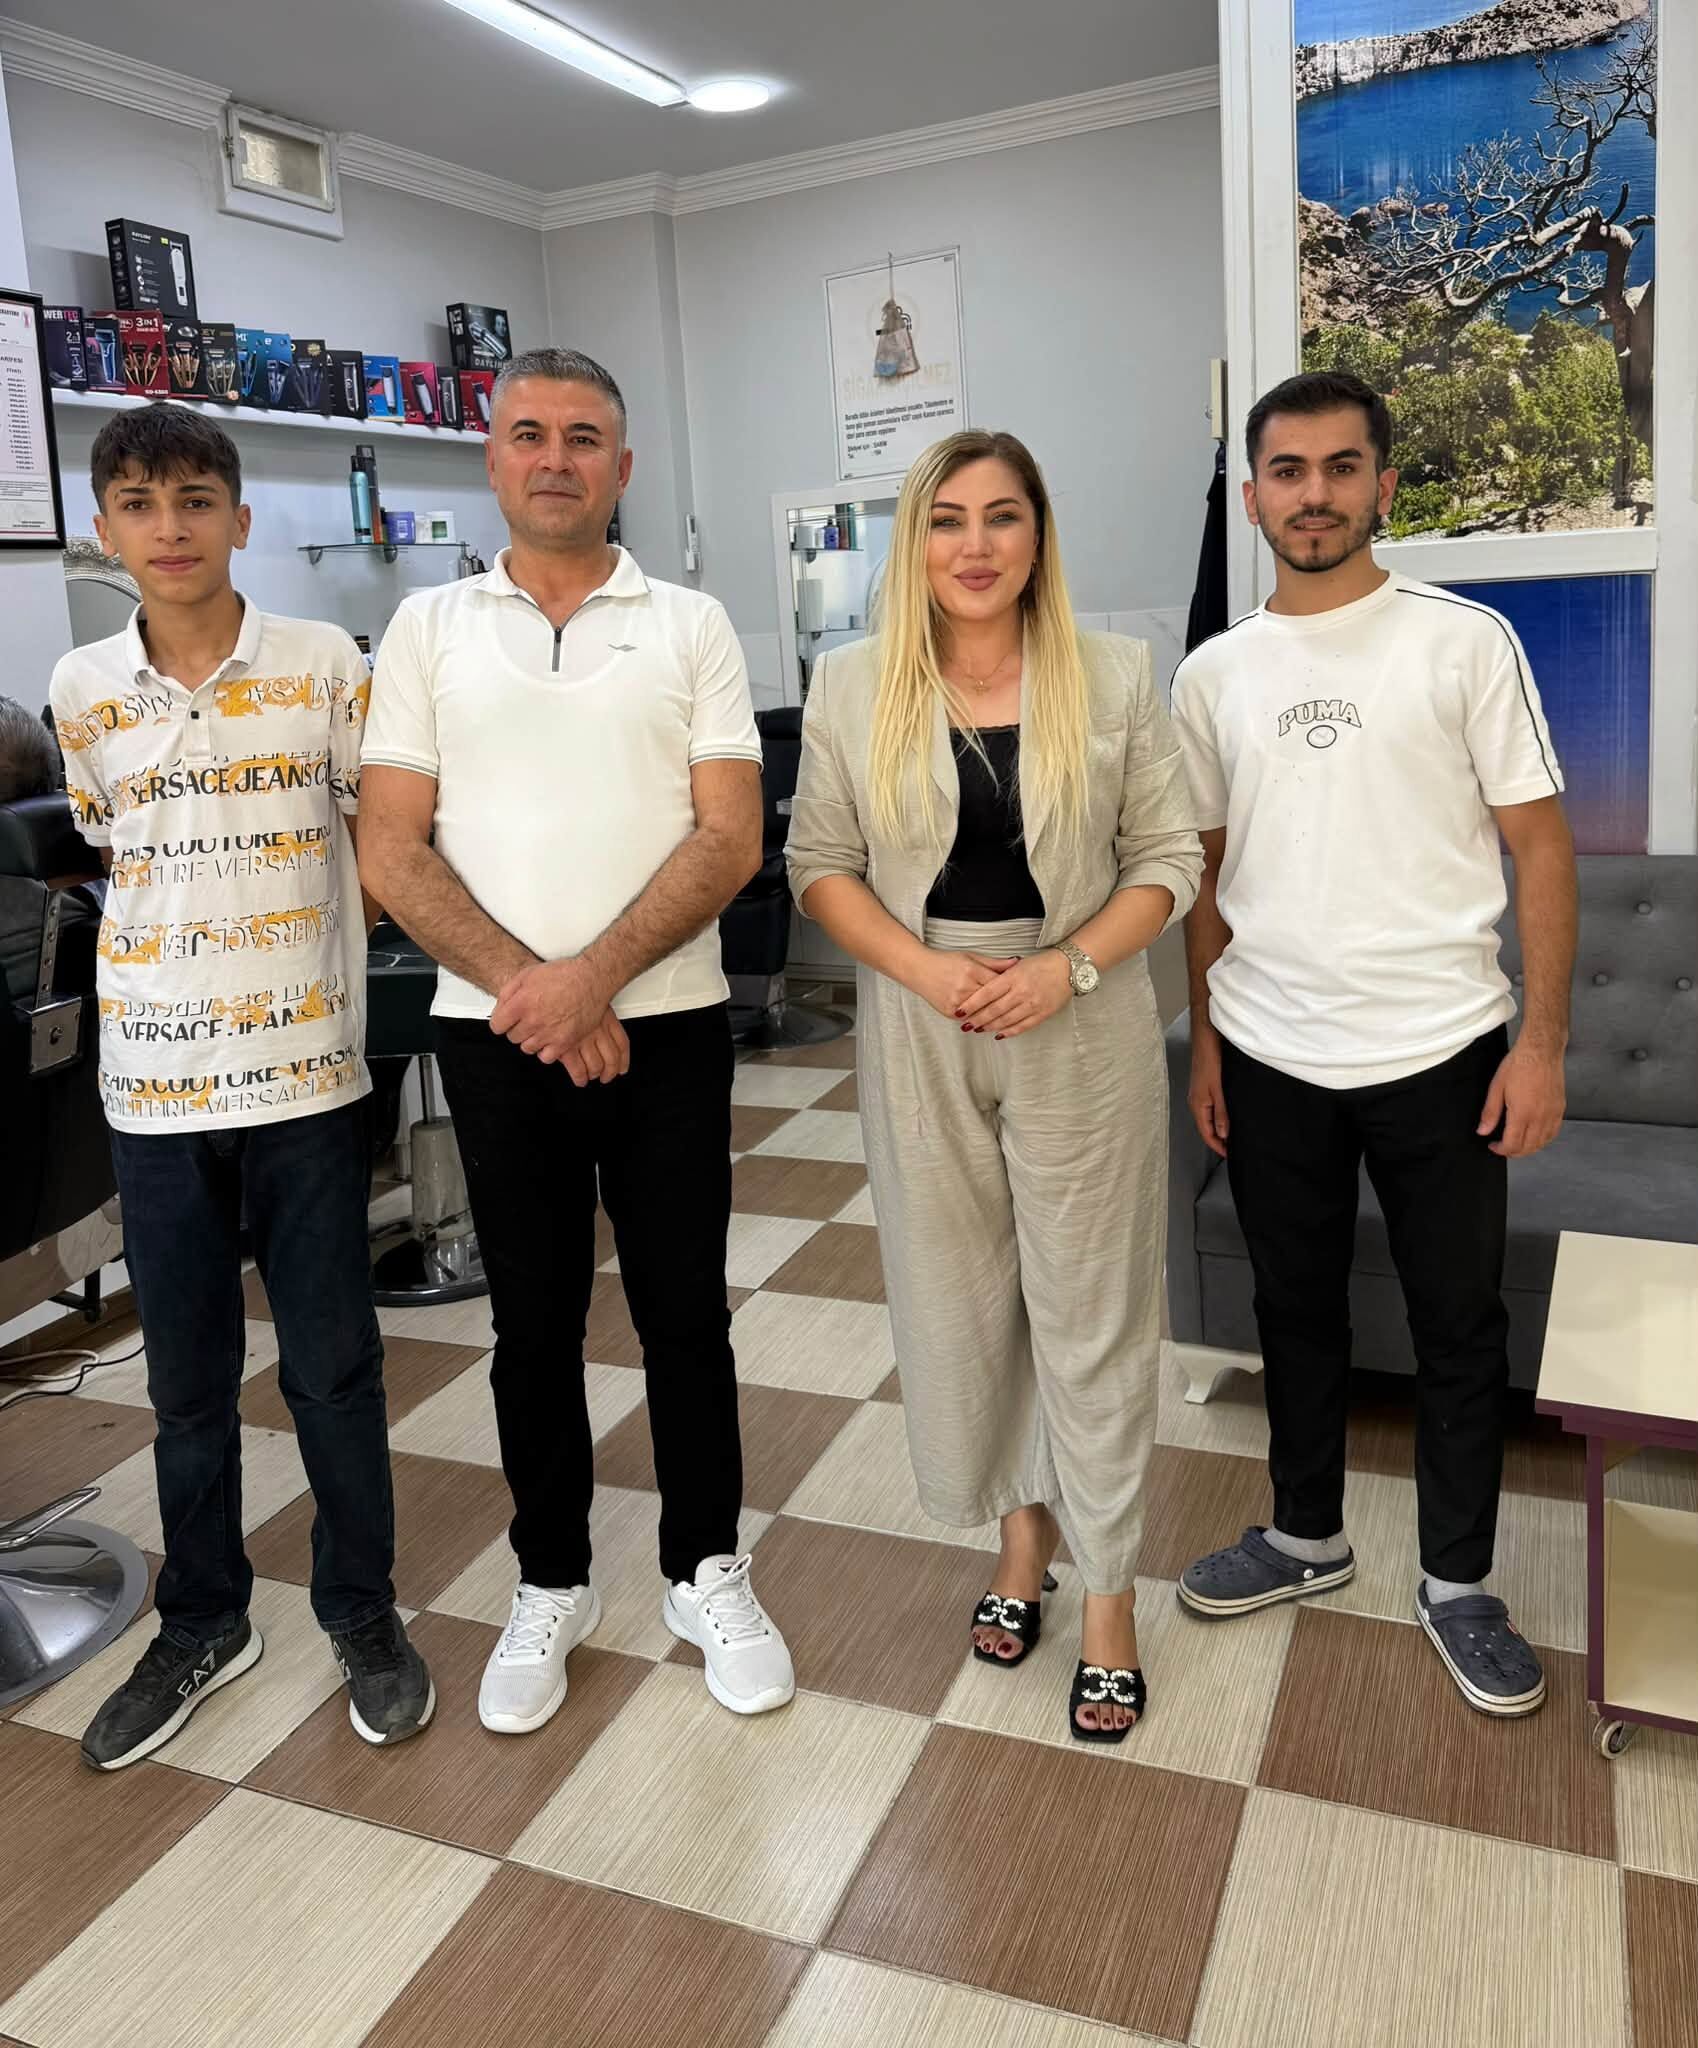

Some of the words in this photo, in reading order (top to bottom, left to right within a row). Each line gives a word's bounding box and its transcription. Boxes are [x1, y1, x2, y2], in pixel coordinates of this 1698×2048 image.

[1278, 699, 1362, 737] PUMA
[235, 763, 311, 792] JEANS
[177, 1649, 216, 1698] EA7
